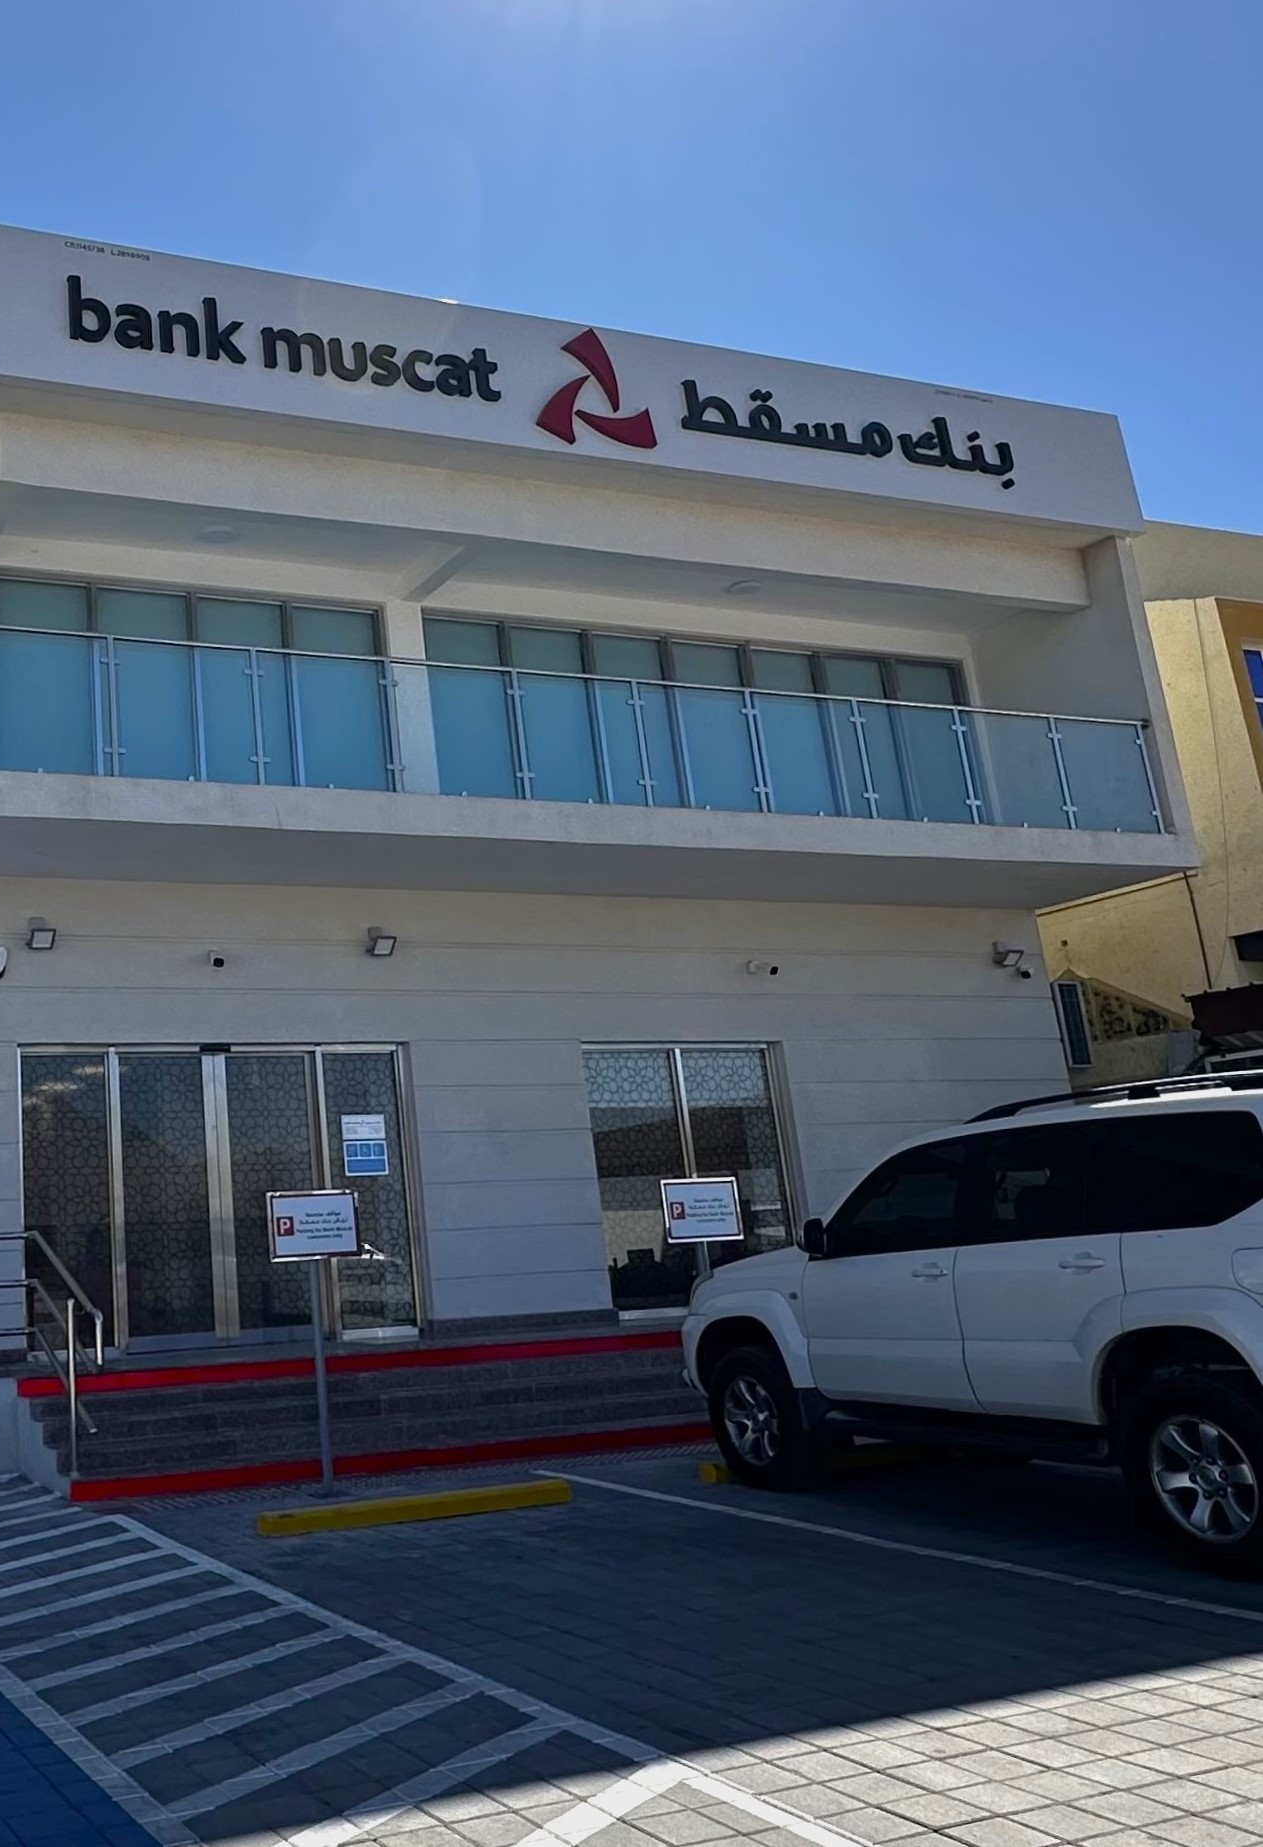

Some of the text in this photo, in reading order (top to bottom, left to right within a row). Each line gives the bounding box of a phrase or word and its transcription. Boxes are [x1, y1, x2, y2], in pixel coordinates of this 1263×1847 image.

[67, 274, 503, 402] bank muscat
[680, 379, 1016, 490] بنك مسقط
